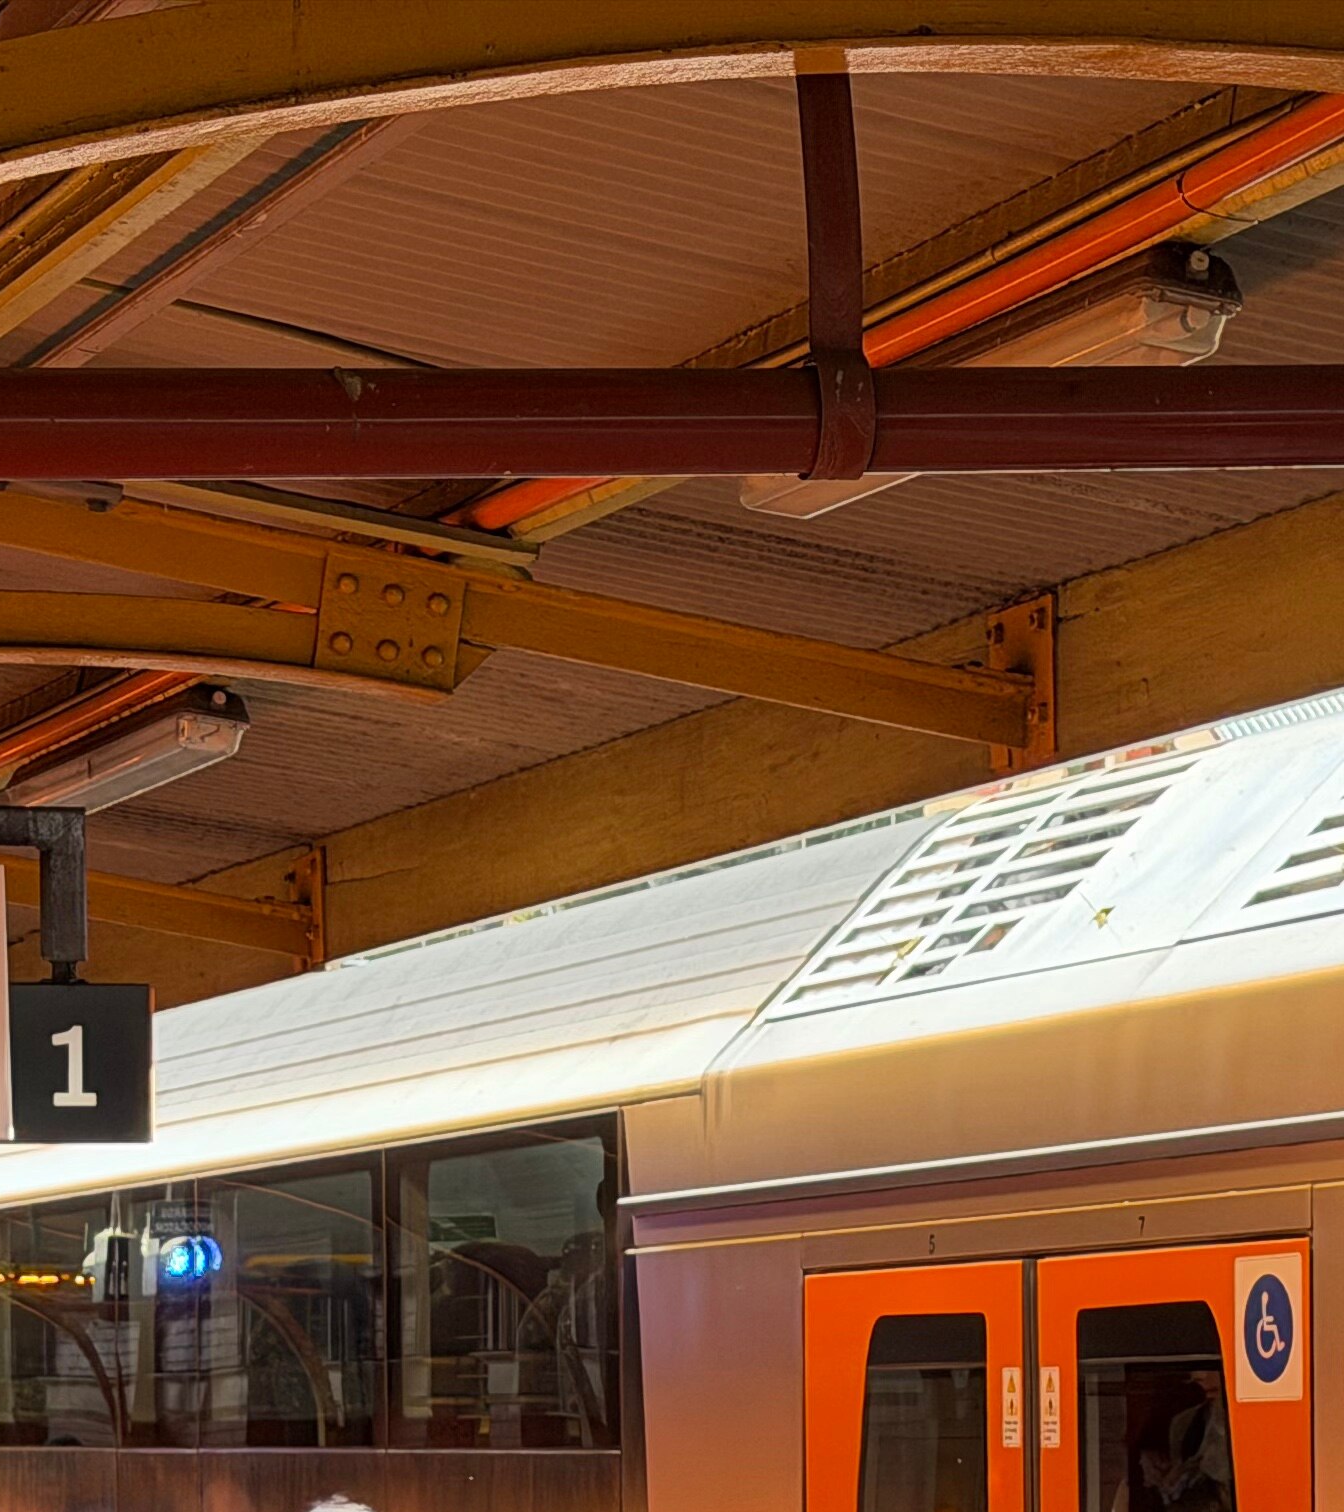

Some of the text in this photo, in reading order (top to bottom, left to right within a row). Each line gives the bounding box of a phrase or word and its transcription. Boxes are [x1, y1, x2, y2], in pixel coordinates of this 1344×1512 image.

[52, 1025, 97, 1107] 1
[1138, 1215, 1146, 1237] 7
[928, 1234, 936, 1255] 5
